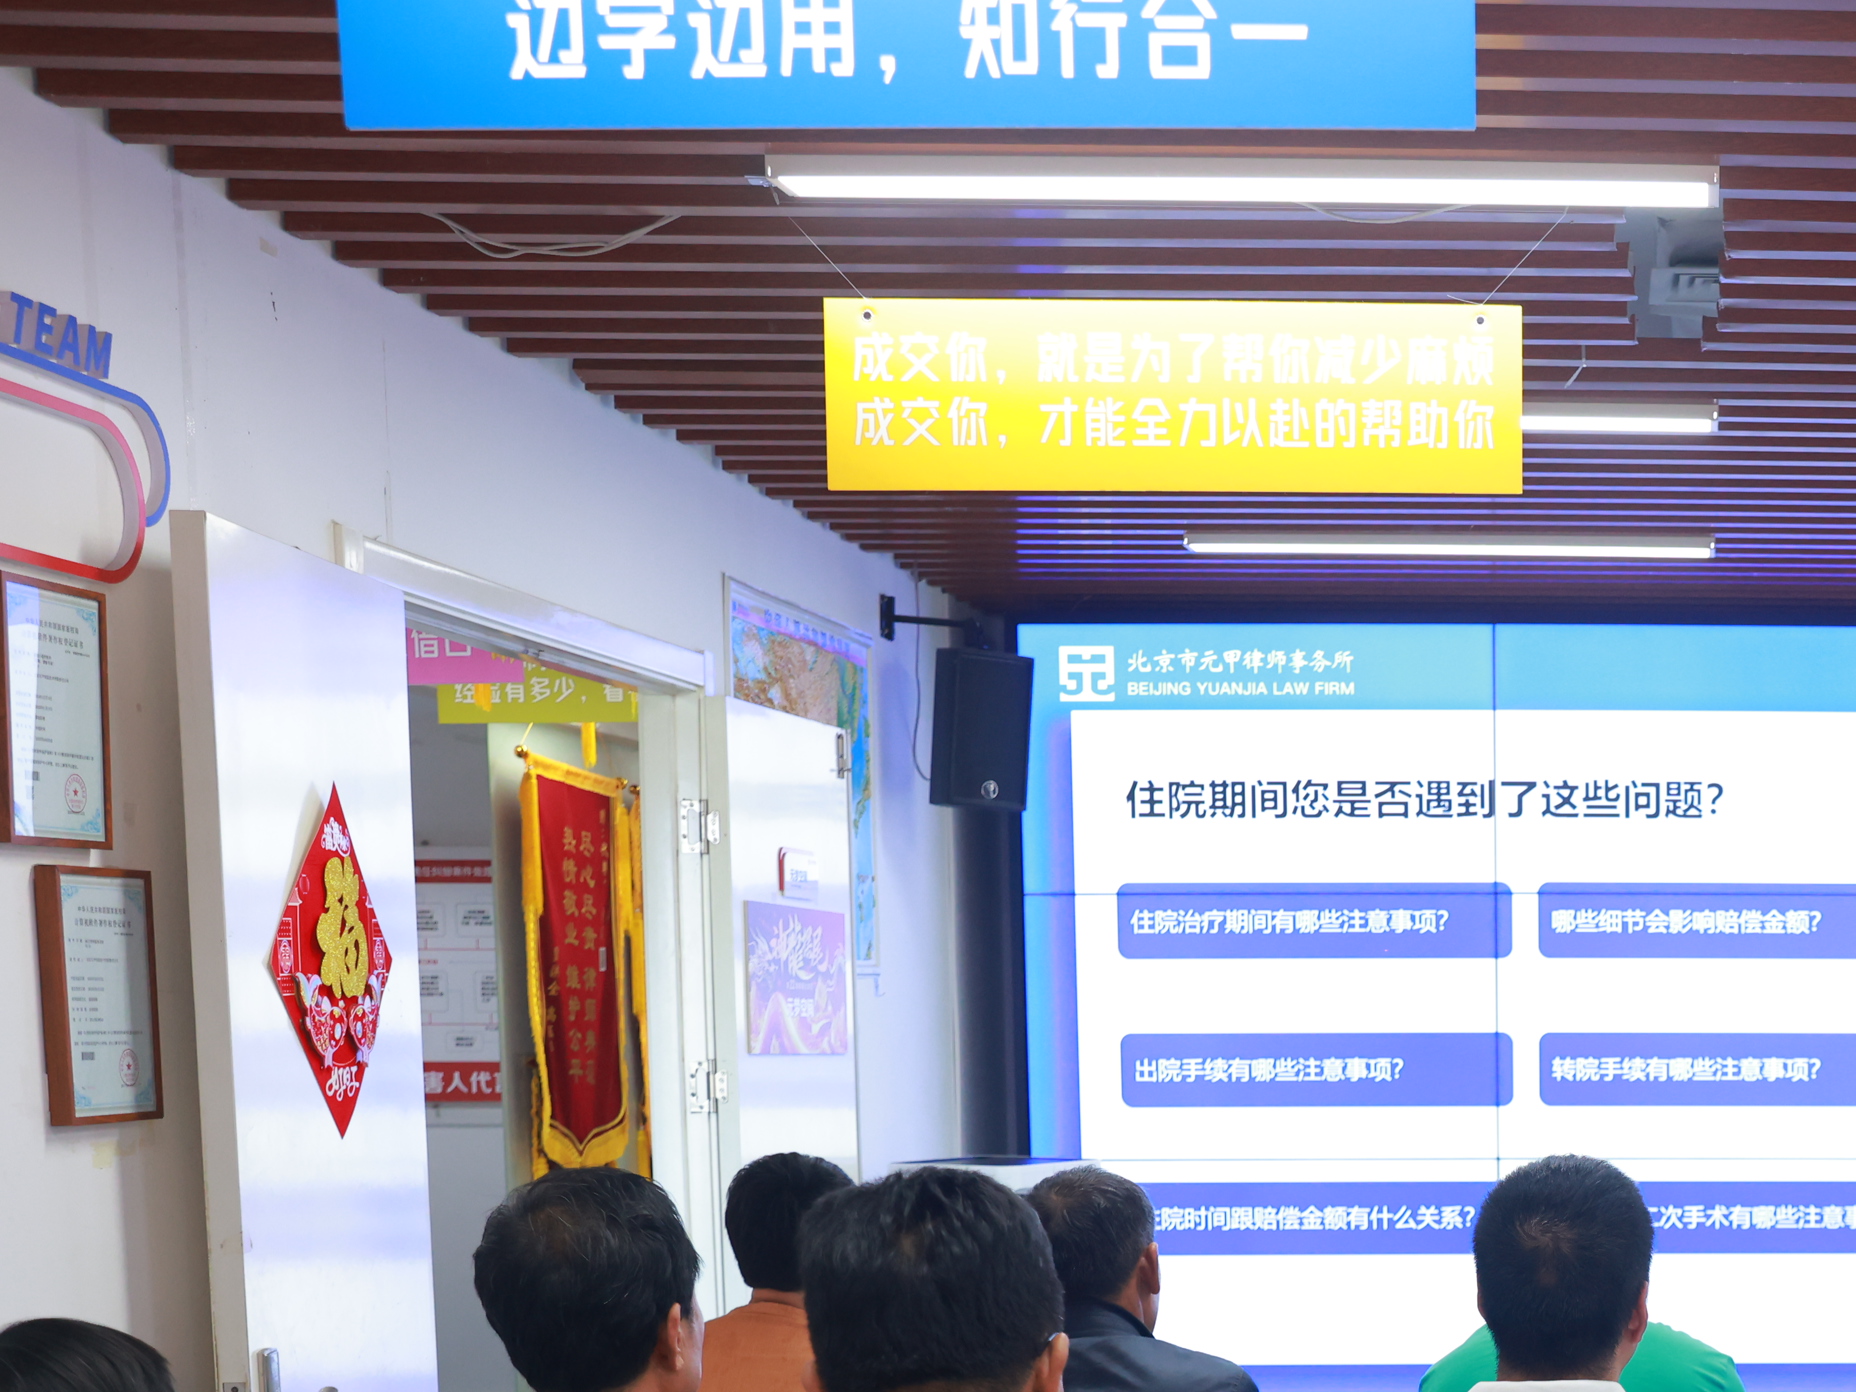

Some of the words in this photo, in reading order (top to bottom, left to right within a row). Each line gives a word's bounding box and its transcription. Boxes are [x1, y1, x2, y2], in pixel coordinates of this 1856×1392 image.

[506, 0, 1309, 84] 边学边用，知行合一
[10, 291, 113, 379] TEAM
[853, 331, 1495, 385] 成交你，就是为了帮你减少麻烦
[855, 397, 1495, 449] 成交你，才能全力以赴的帮助你
[1127, 648, 1354, 674] 北京市元甲律师事务所
[1127, 681, 1192, 695] BEIJING
[1197, 681, 1268, 695] YUANJIA
[1273, 681, 1309, 695] LAW
[1314, 681, 1355, 695] FIRM
[1126, 780, 1724, 819] 住院期间您是否遇到了这些问题？
[1130, 909, 1449, 935] 住院治疗期间有哪些注意事项？
[1552, 909, 1822, 936] 哪些细节会影响赔偿金额？
[1135, 1057, 1405, 1083] 出院手续有哪些注意事项？
[1552, 1056, 1822, 1083] 转院手续有哪些注意事项？
